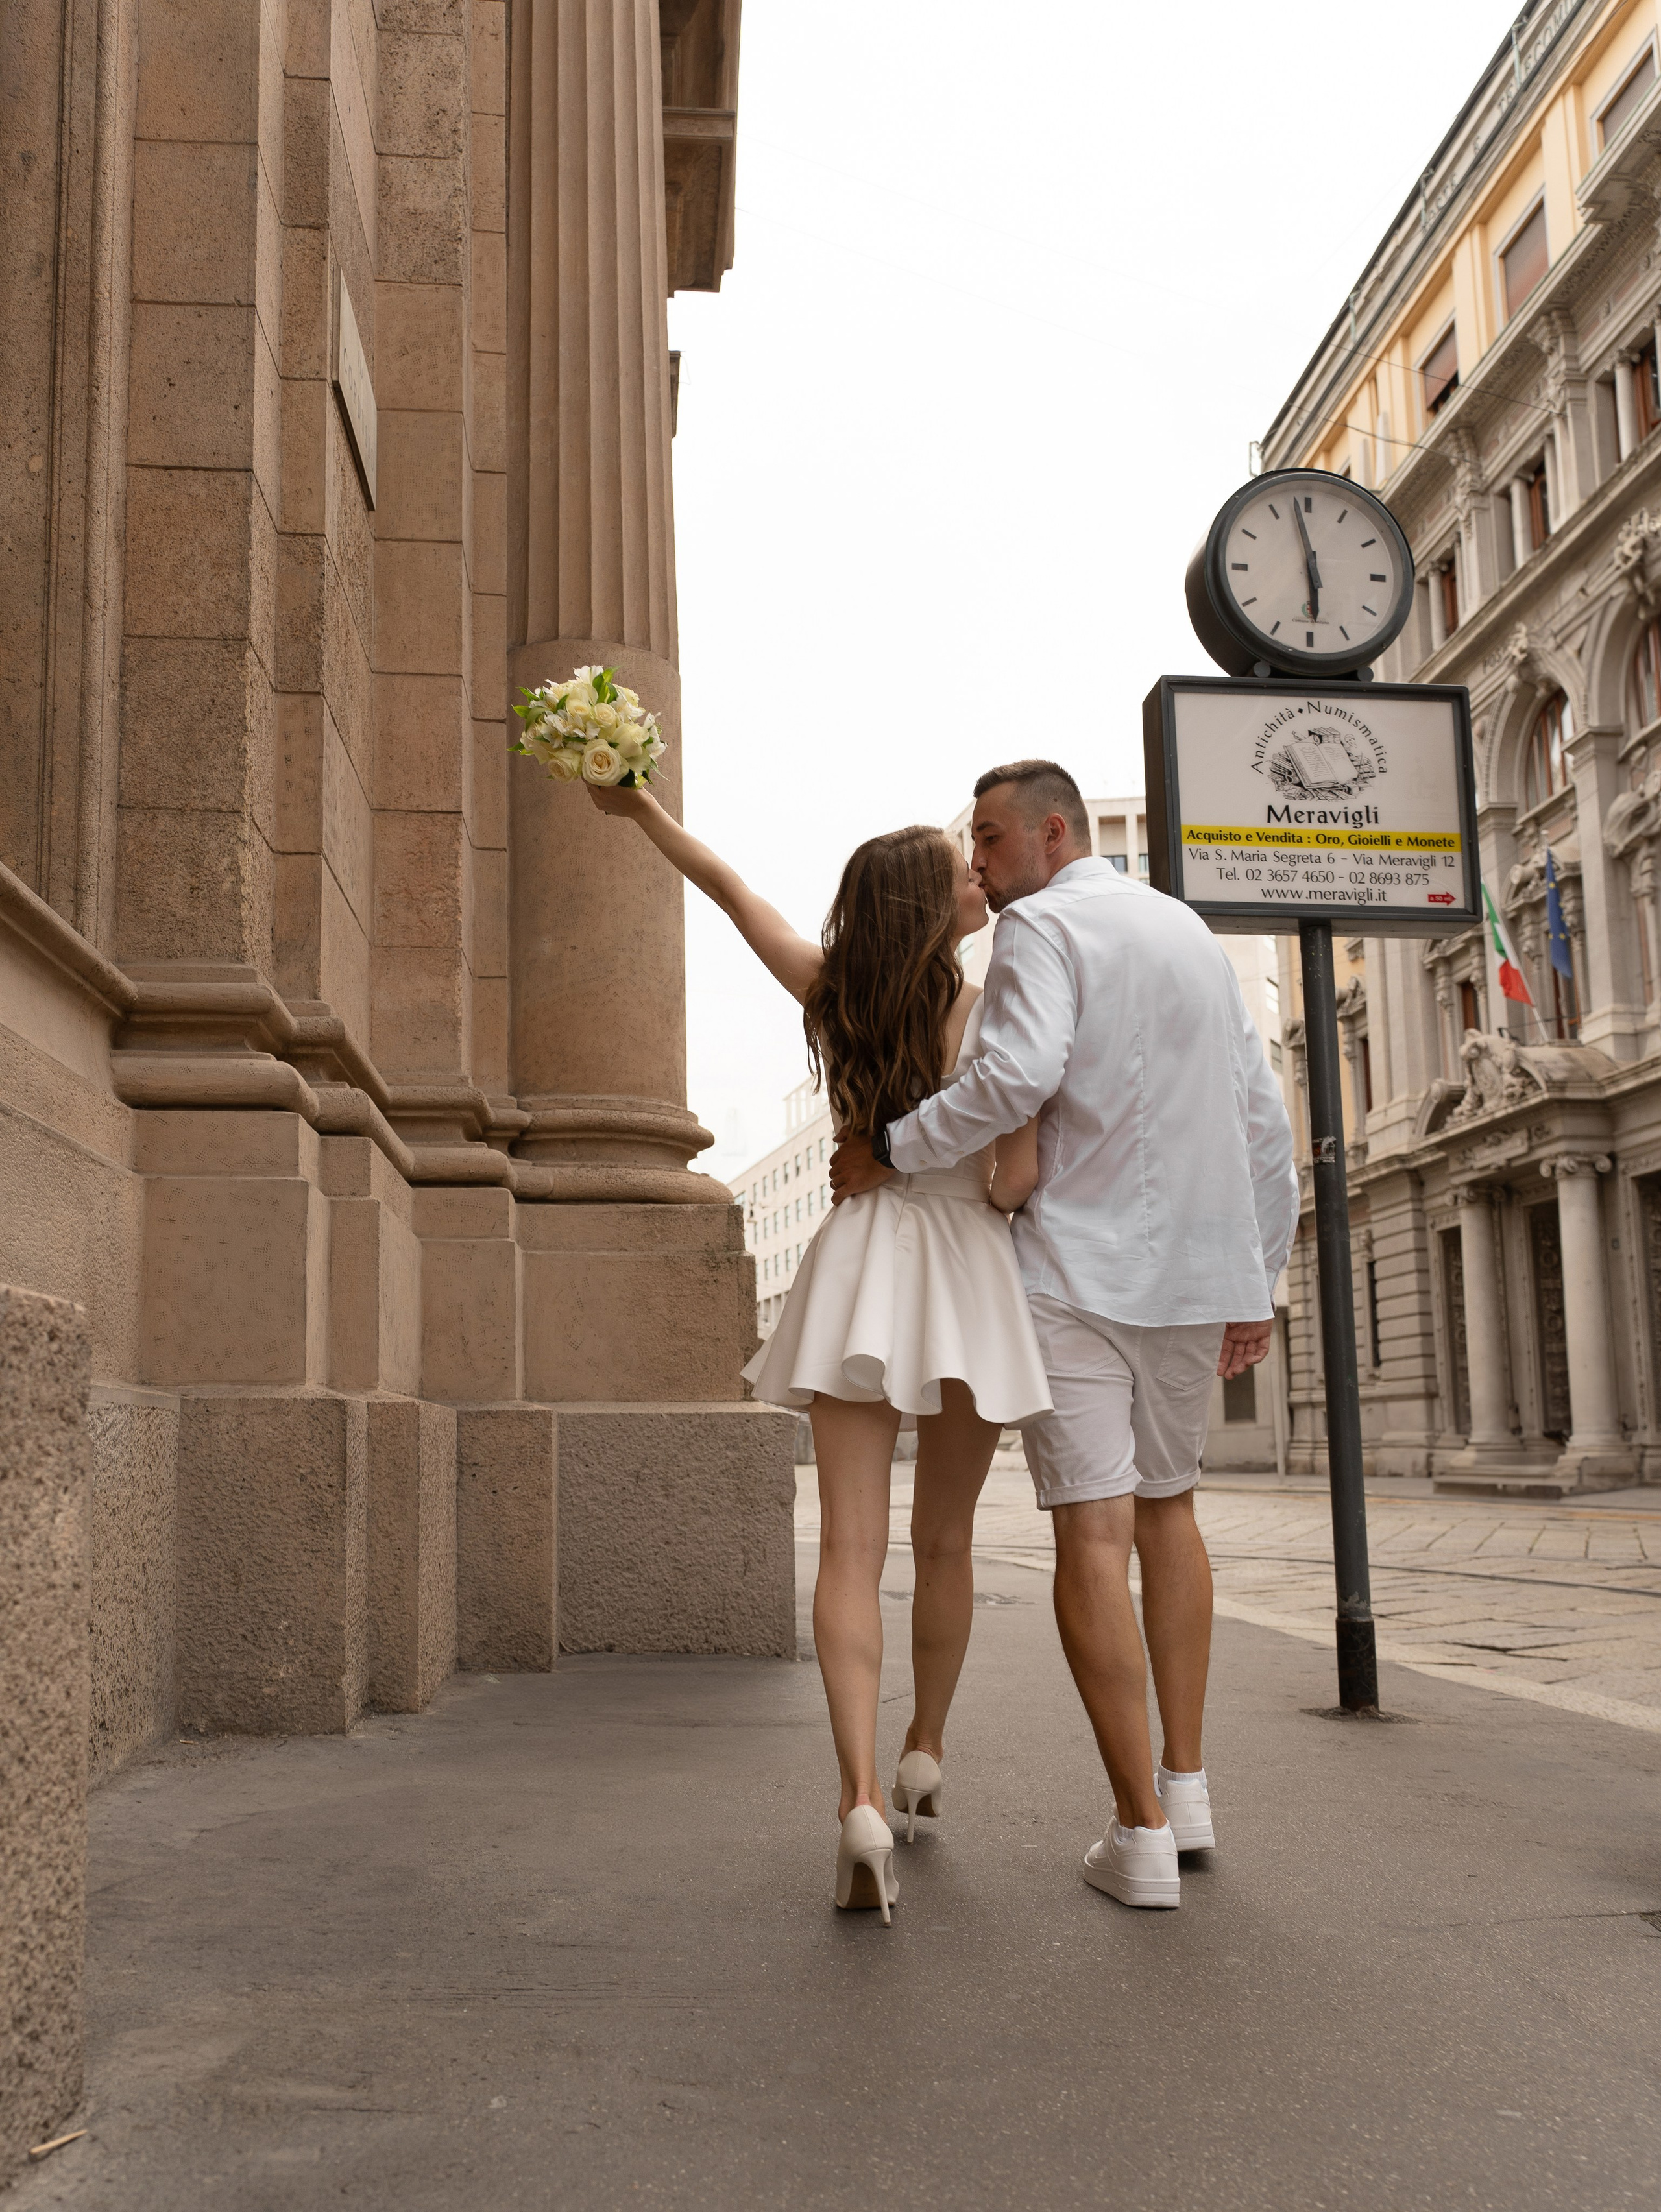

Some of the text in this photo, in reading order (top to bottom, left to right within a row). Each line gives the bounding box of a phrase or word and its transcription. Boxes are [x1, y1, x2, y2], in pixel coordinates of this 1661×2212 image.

[1251, 701, 1388, 775] Antichità Numismatica
[1267, 804, 1380, 829] Meravigli
[1187, 829, 1241, 843] Acquisto
[1255, 832, 1303, 843] Vendita
[1316, 834, 1344, 847] Oro,
[1348, 834, 1391, 846] Gioielli
[1395, 838, 1403, 847] e
[1407, 836, 1455, 847] Monete
[1189, 848, 1209, 860] Via
[1215, 848, 1227, 861] S.
[1231, 850, 1267, 862] Maria
[1273, 850, 1322, 867] Segreta
[1327, 852, 1335, 864] 6
[1352, 853, 1374, 865] Via
[1379, 854, 1437, 871] Meravigli
[1441, 856, 1455, 867] 12
[1216, 867, 1239, 880] Tel.
[1246, 869, 1262, 881] 02
[1267, 869, 1298, 882] 3657
[1302, 870, 1335, 883] 4650
[1349, 872, 1365, 884] 02
[1369, 872, 1401, 885] 8693
[1405, 873, 1429, 886] 875
[1261, 888, 1387, 906] www.meravigli.it
